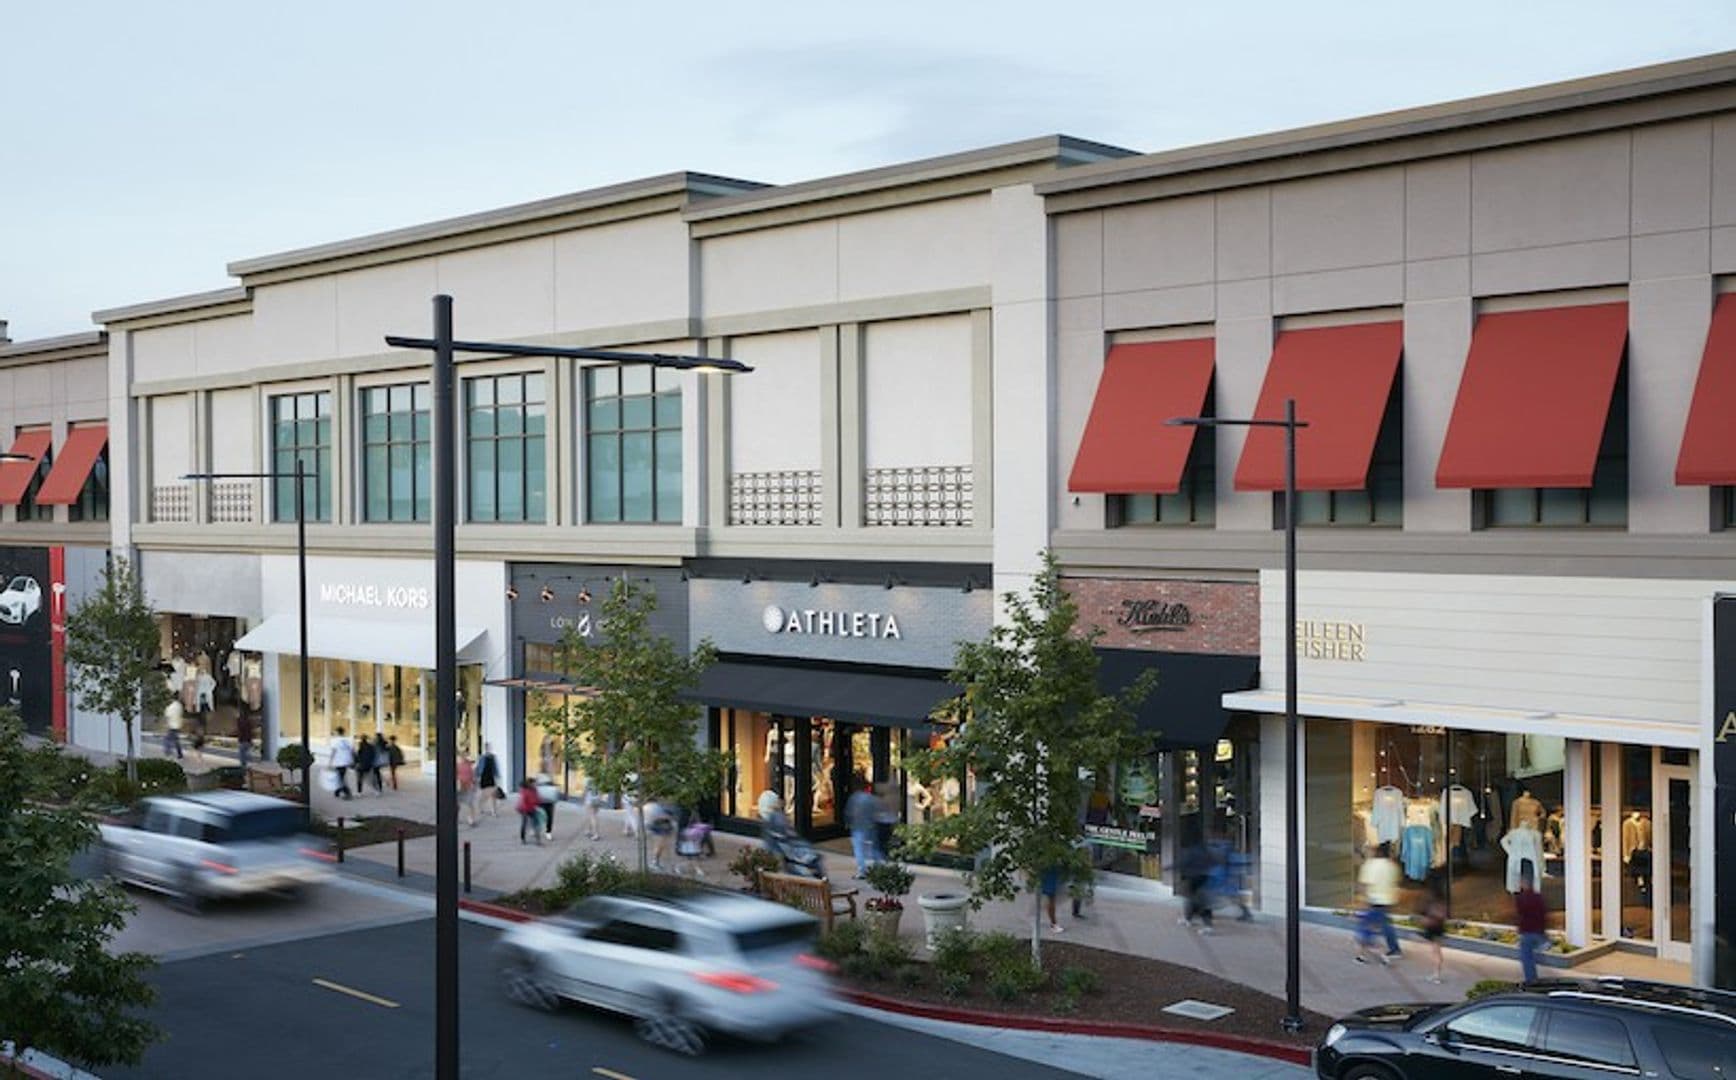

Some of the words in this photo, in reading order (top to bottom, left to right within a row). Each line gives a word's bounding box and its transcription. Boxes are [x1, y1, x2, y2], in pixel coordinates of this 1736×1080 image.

[320, 583, 383, 607] MICHAEL
[386, 585, 430, 608] KORS
[785, 609, 902, 640] ATHLETA
